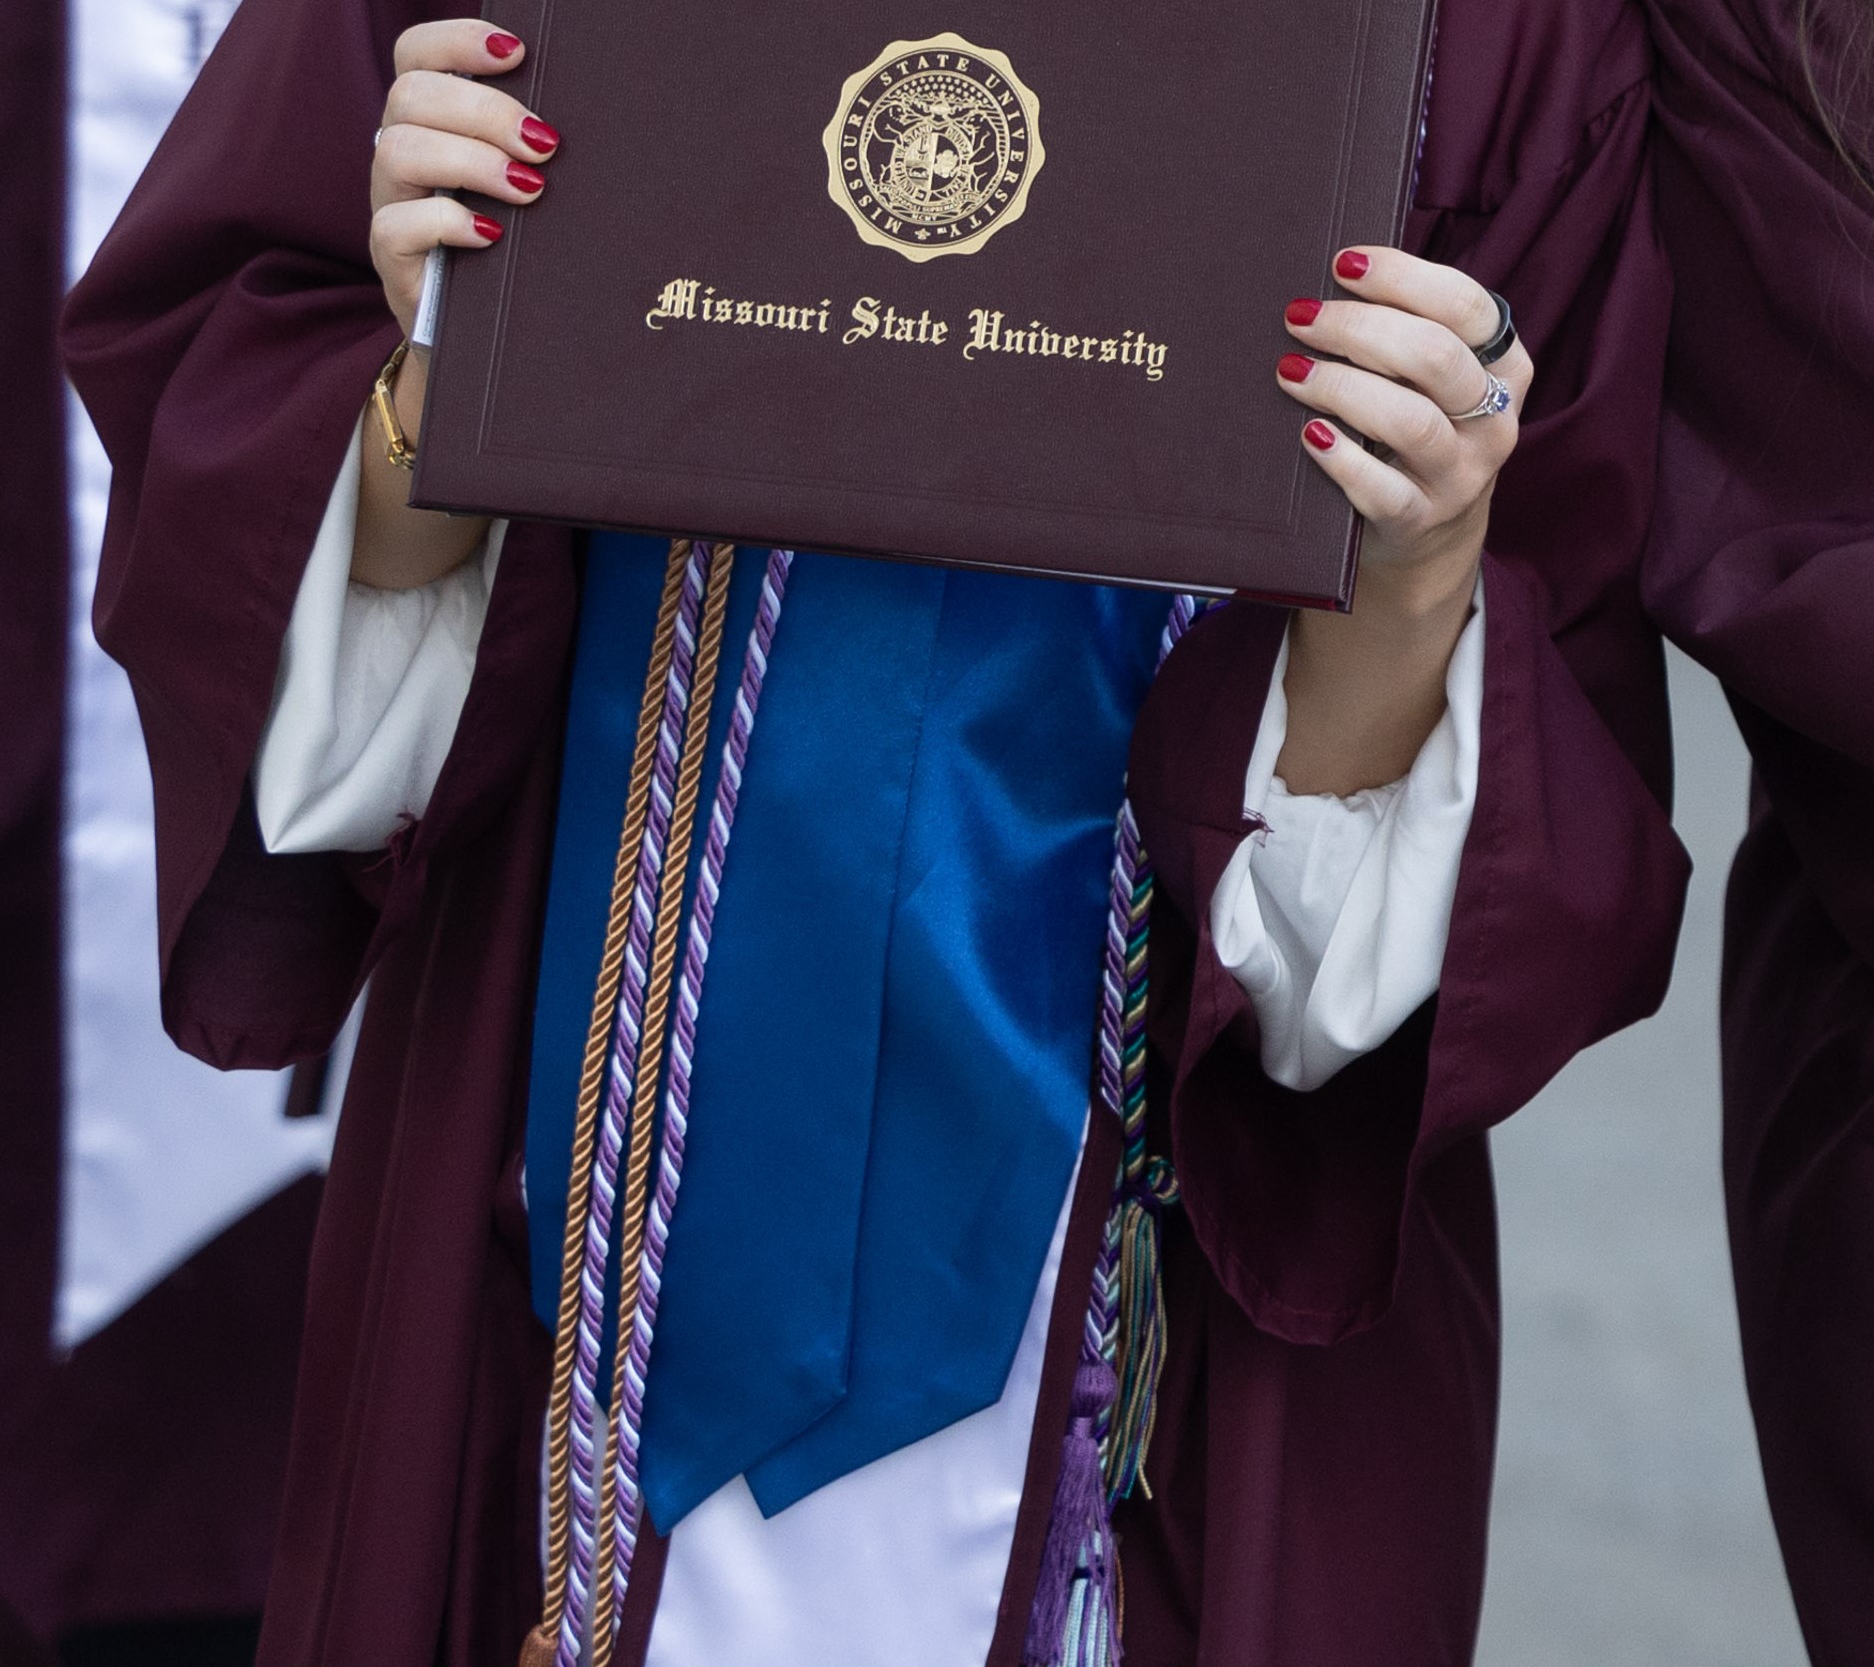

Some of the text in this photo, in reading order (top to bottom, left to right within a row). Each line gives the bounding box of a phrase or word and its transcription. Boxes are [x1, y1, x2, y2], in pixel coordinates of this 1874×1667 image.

[844, 54, 1025, 238] MISSOURI STATE UNIVERSITY
[646, 278, 1168, 381] Missouri State University
